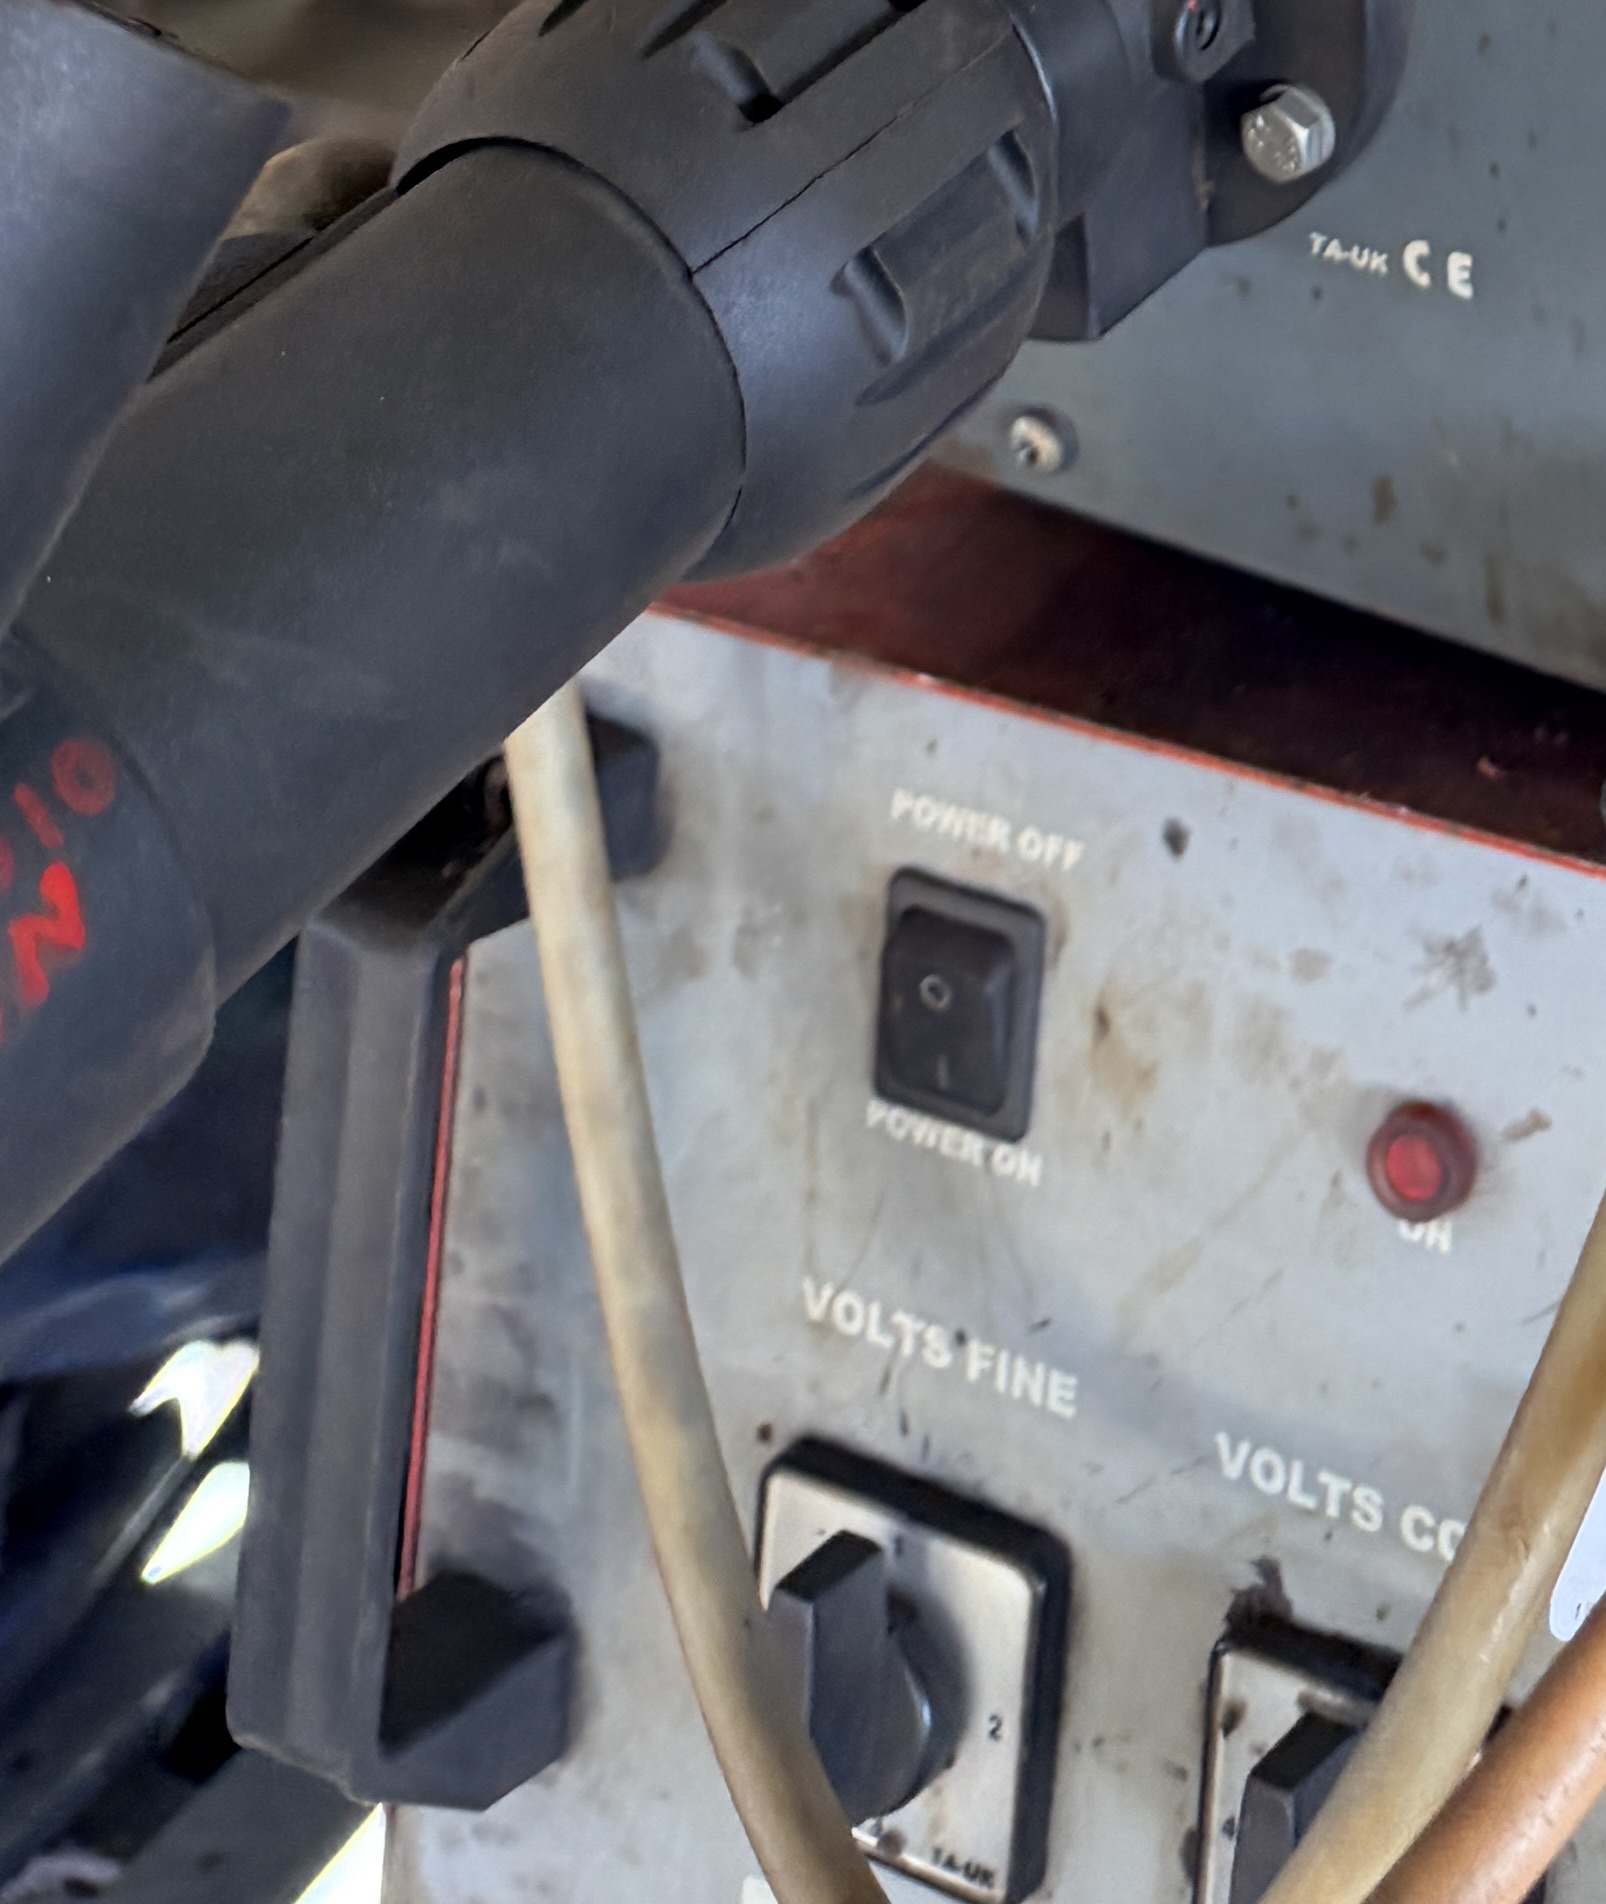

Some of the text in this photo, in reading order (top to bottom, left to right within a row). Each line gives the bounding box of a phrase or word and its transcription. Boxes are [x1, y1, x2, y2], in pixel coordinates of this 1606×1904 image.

[889, 788, 1085, 872] POWER OFF
[865, 1098, 1044, 1188] POWER ON
[802, 1277, 1079, 1418] VOLTS FINE
[1213, 1432, 1384, 1534] VOLTS
[988, 1714, 1003, 1742] 2
